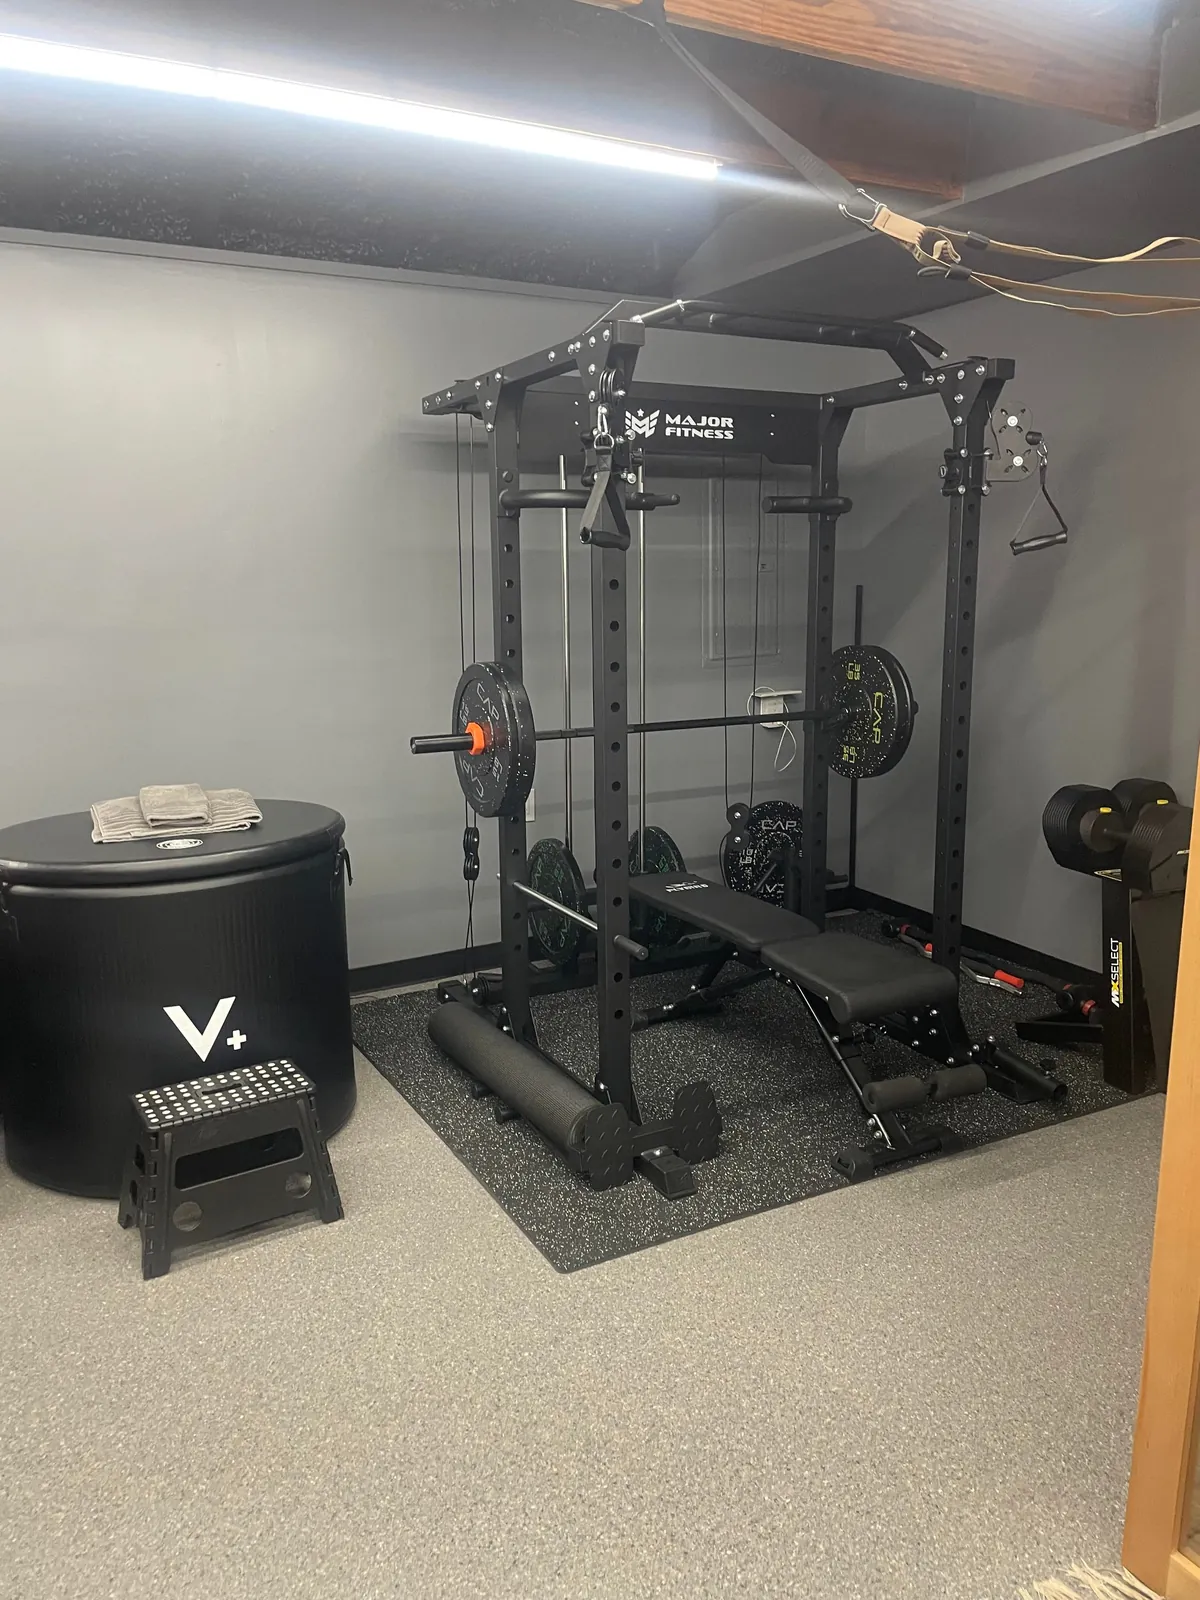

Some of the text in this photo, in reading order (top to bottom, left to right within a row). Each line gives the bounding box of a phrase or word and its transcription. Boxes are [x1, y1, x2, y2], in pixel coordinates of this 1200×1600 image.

[665, 413, 734, 429] MAJOR
[665, 427, 734, 440] FITNESS
[477, 682, 500, 720] CAP
[873, 692, 883, 744] CAP
[462, 757, 485, 798] CAP
[761, 819, 797, 831] CAP
